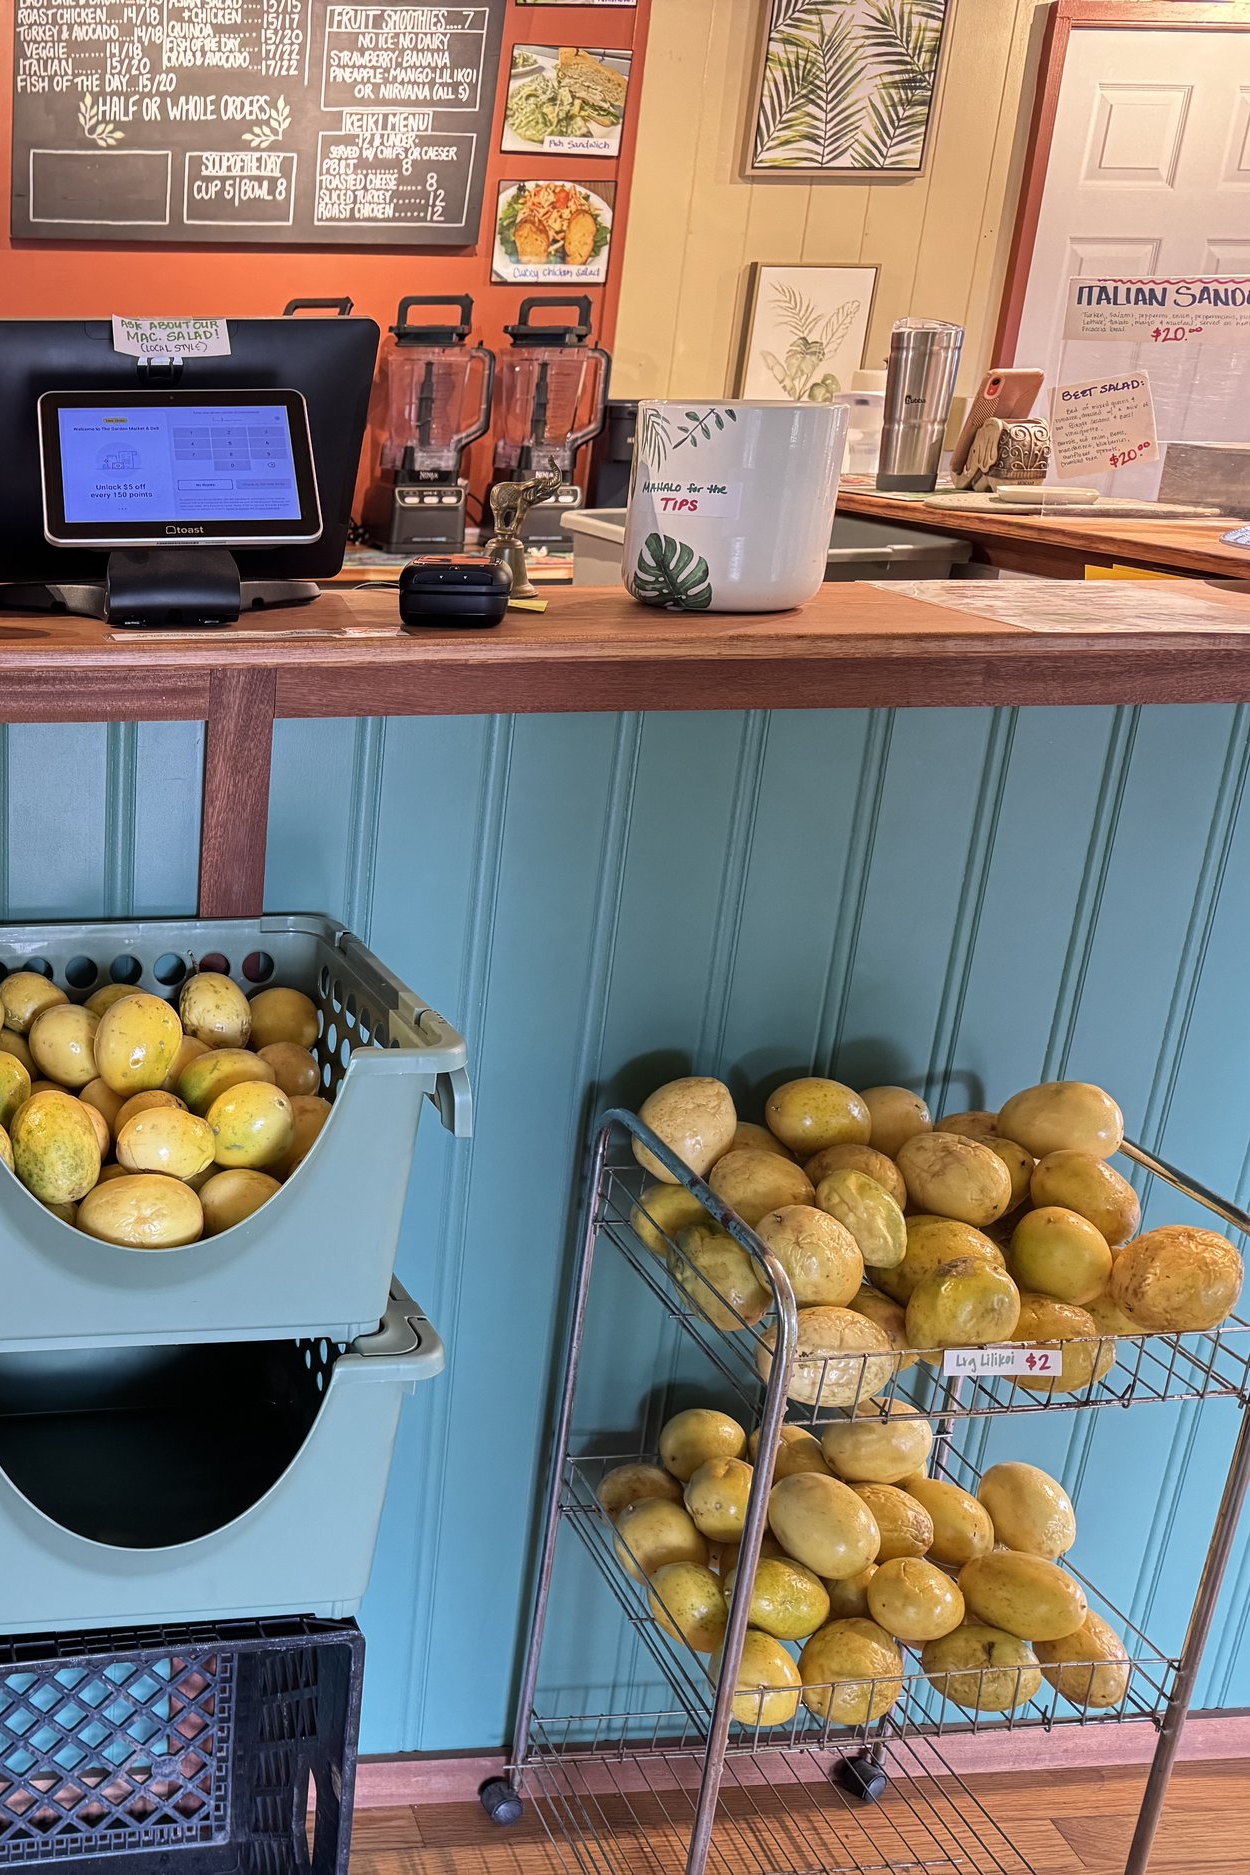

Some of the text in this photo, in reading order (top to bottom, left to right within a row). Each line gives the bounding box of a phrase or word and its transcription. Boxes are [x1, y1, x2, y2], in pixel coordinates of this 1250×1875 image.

[17, 7, 160, 26] ROAST CHICKEN 14/18
[263, 14, 300, 30] 15/17
[333, 8, 475, 31] FRUIT SMOOTHIES 7
[16, 24, 164, 46] TURKEY & AVOCADO 14/18
[168, 21, 303, 44] QUINOA 15/20
[358, 33, 450, 50] NO ICE NO DAIRY
[23, 42, 143, 60] VEGGIE 14/18
[166, 37, 300, 61] FISH OF THE DAY 17/22
[19, 57, 150, 76] ITALIAN 15/20
[165, 52, 299, 77] CRAB & AVOCADO 17/22
[330, 50, 450, 68] STRAWBERRY BANANA
[17, 73, 177, 94] FISH OF THE DAY 15/20
[330, 67, 477, 83] PINEAPPLE MANGO LILIKOI
[354, 83, 470, 102] OR NIRVANA (ALL 5)
[98, 95, 271, 121] HALF OR WHOLE ORDERS
[345, 112, 430, 132] KEIKI MENU
[357, 133, 416, 148] 12 & UNDER
[567, 139, 610, 149] Sandwich
[329, 145, 457, 162] SERVED W/ CHIPS OR CAESER
[202, 154, 284, 174] SOUP OF THE DAY
[322, 159, 413, 175] PB&J 8
[194, 177, 287, 200] CUP 5 BOWL 8
[319, 172, 438, 191] TOASTED CHEESE 8
[319, 189, 446, 206] SLICED TURKEY 12
[318, 203, 445, 221] ROAST CHICKEN 12
[1077, 285, 1250, 308] ITALIAN SAND
[120, 319, 219, 331] ASK ABOUT OUR
[126, 328, 220, 343] MAC. SALAD!
[140, 341, 208, 353] (LOCAL STYLE)
[1062, 379, 1144, 401] BEET SALAD:
[1109, 441, 1151, 468] $20.00
[90, 492, 111, 500] every
[129, 491, 153, 499] points
[123, 483, 134, 491] $5
[642, 481, 728, 494] MAHALO for the
[660, 497, 698, 512] TIPS
[176, 526, 204, 534] toast
[955, 1351, 1051, 1373] Lrg Lilikoi $2
